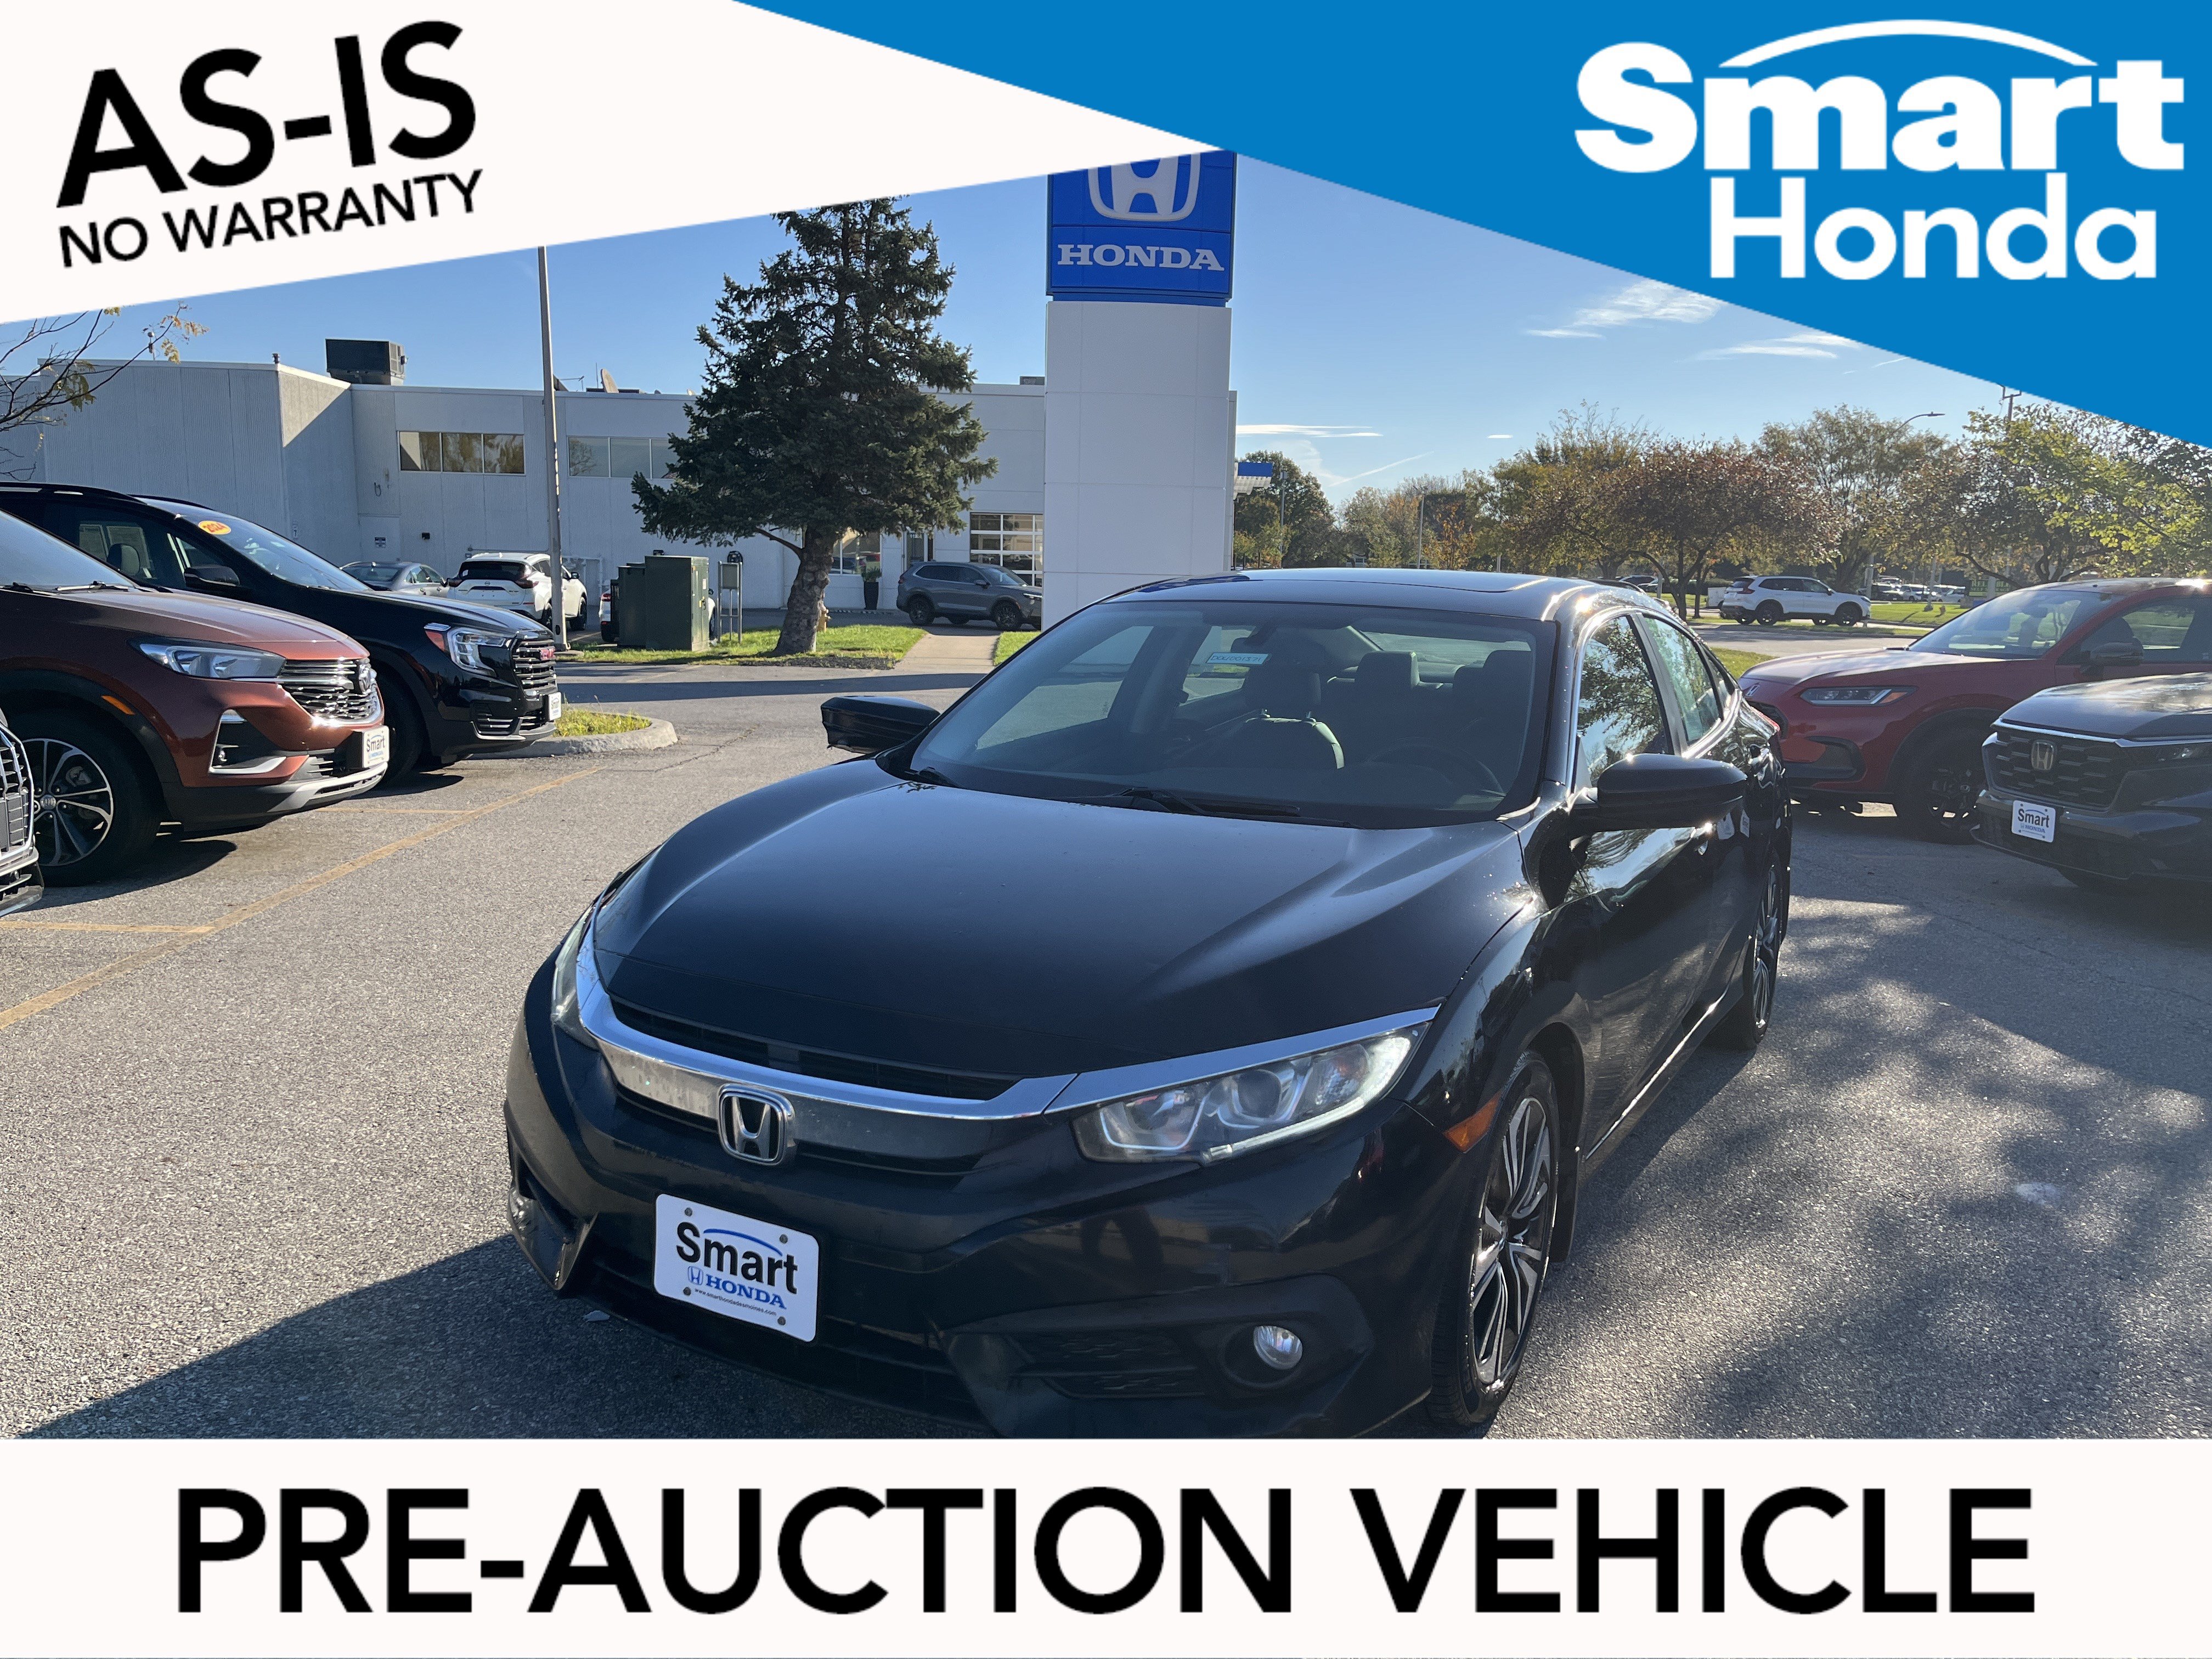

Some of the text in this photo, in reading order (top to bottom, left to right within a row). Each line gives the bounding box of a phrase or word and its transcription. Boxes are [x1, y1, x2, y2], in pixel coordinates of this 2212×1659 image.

[1057, 244, 1224, 272] HONDA
[366, 736, 385, 752] Smart
[2018, 808, 2050, 828] Smart
[2025, 825, 2045, 833] HONDA
[676, 1222, 798, 1294] Smart
[706, 1274, 787, 1310] HONDA
